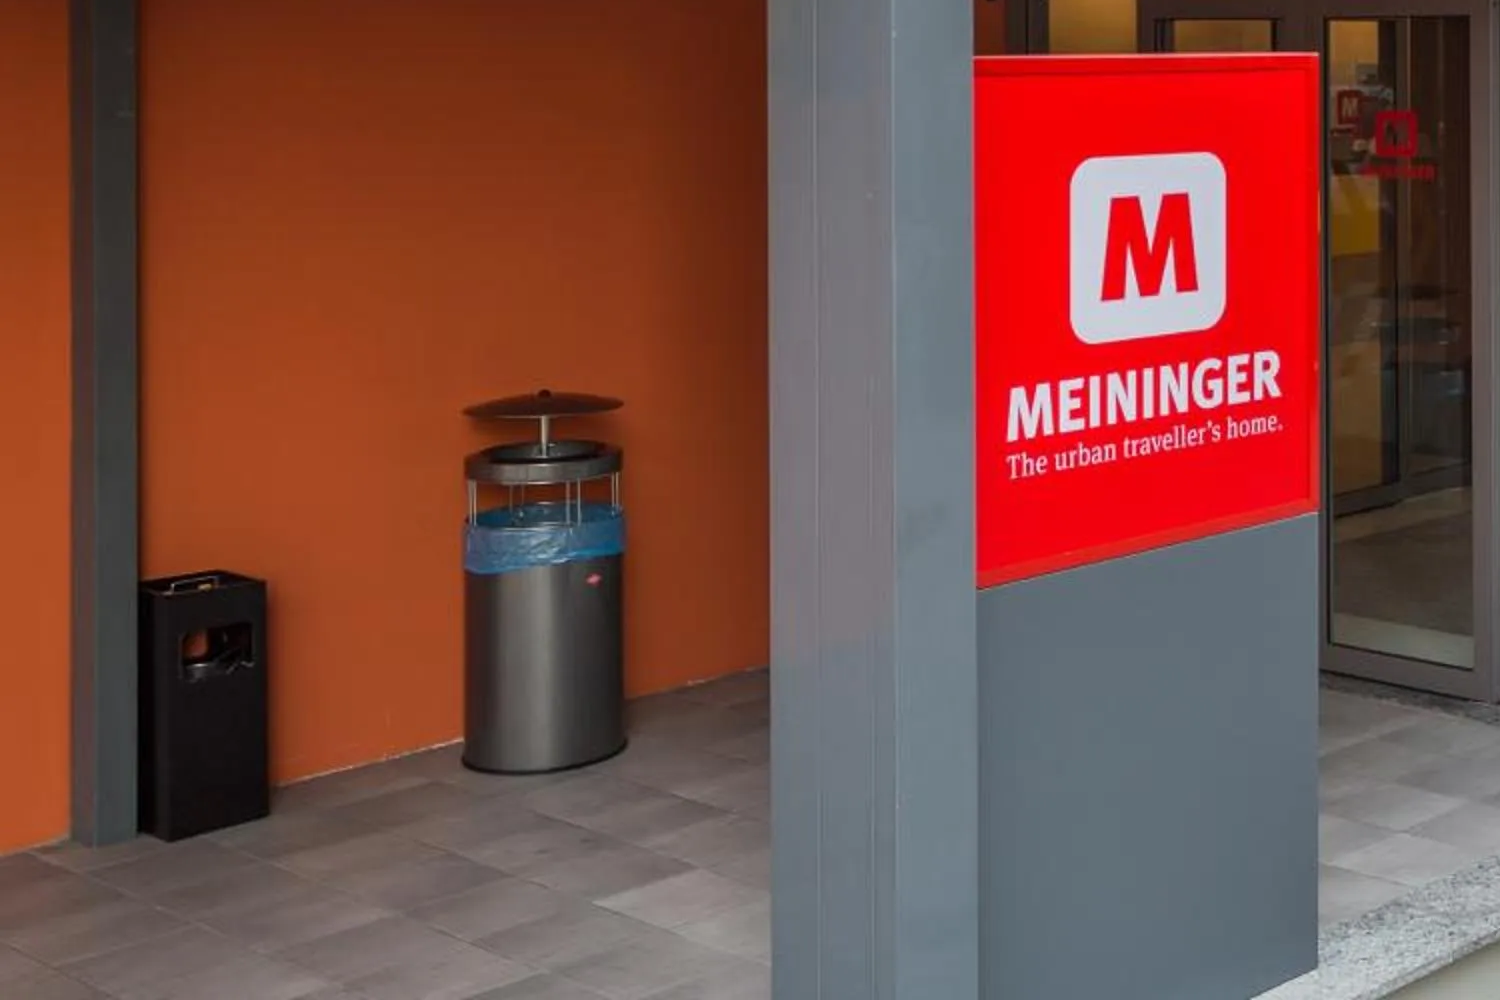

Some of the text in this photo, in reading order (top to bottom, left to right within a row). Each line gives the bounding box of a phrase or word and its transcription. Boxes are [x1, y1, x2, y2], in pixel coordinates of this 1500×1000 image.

[1101, 192, 1198, 301] M
[1007, 350, 1282, 443] MEININGER
[1006, 416, 1284, 479] The urban traveller's home.
